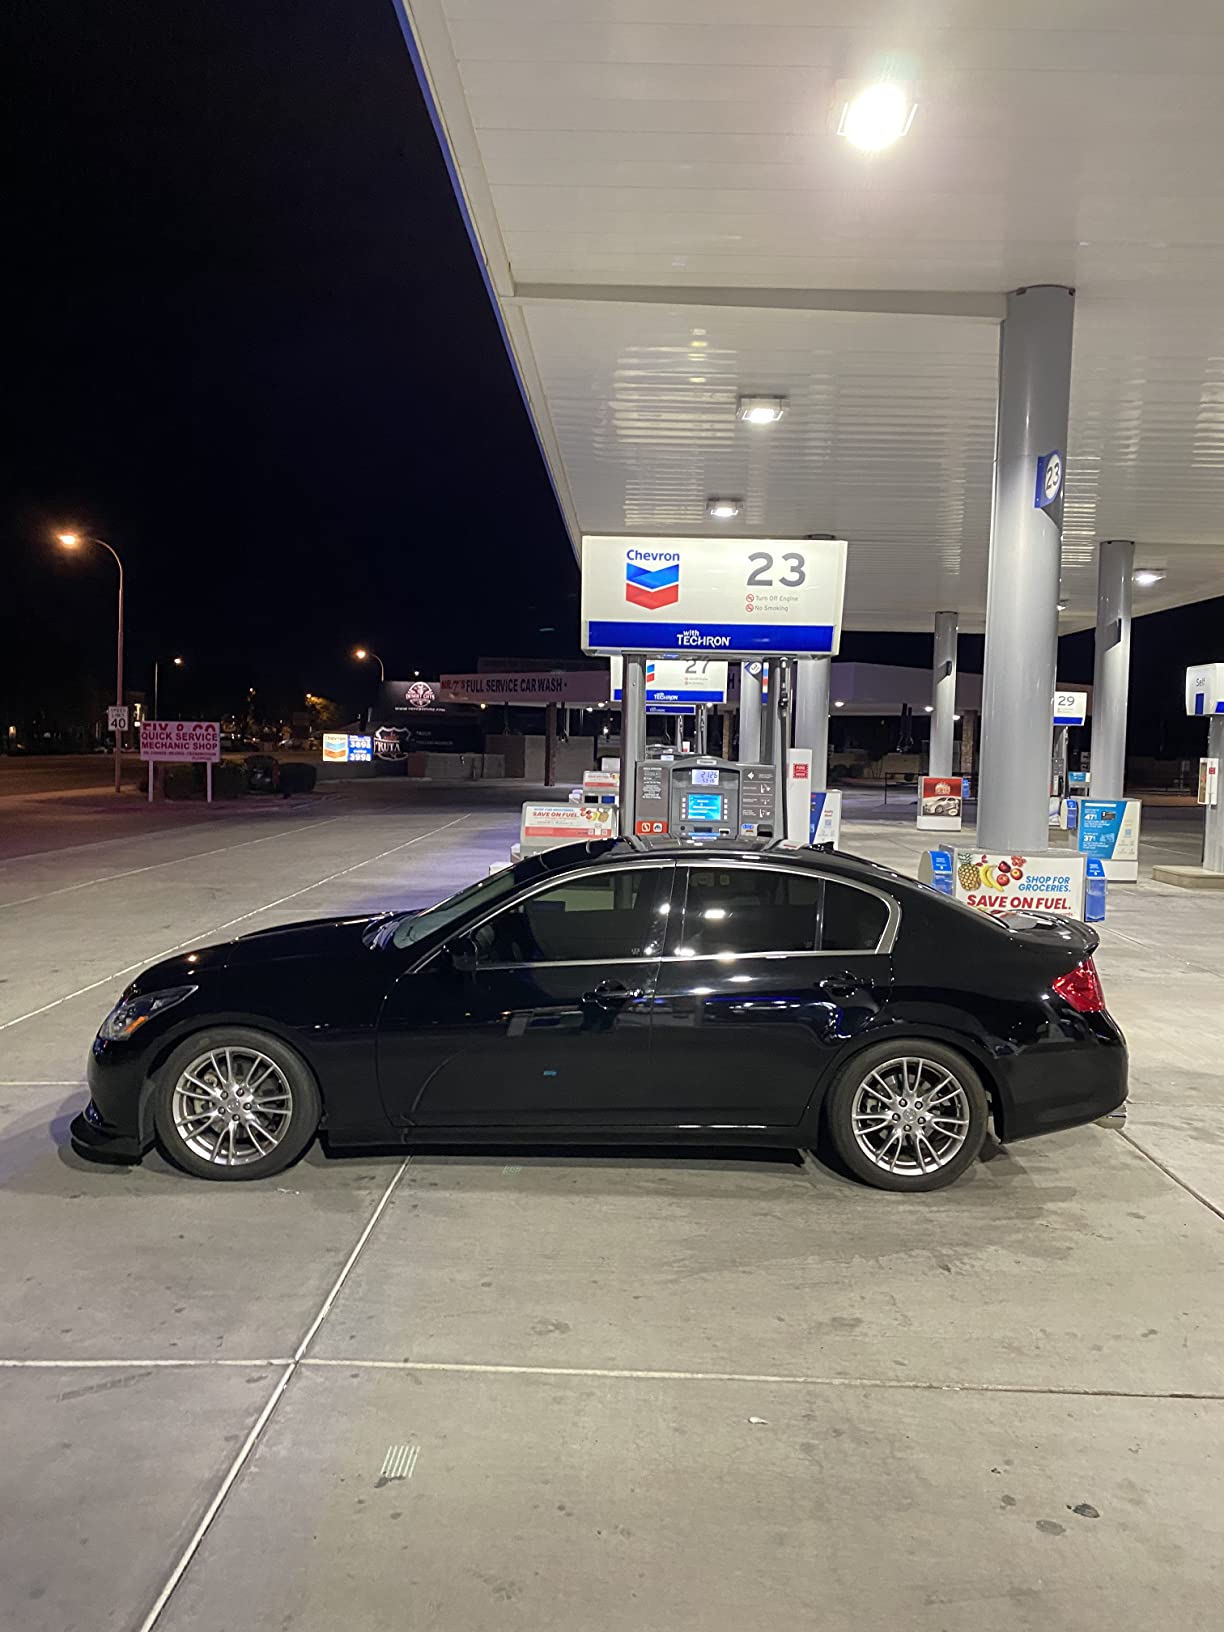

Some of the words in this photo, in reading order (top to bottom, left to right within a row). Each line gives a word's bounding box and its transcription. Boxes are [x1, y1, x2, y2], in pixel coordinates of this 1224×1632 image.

[1046, 462, 1059, 490] 23
[626, 549, 680, 561] Chevron
[747, 552, 806, 587] 23
[779, 595, 799, 603] Engine
[676, 634, 731, 648] TECHRON
[685, 660, 710, 674] 27
[466, 680, 484, 693] FULL
[486, 679, 518, 693] SERVICE
[520, 679, 536, 692] CAR
[536, 678, 562, 692] WASH
[1057, 695, 1075, 706] 29
[110, 718, 126, 729] 40
[141, 731, 172, 741] QUICK
[176, 733, 218, 742] SERVICE
[192, 742, 218, 750] SHOP
[1025, 875, 1051, 884] SHOP
[1052, 876, 1071, 884] FOR
[1018, 883, 1071, 892] GROCERIES.
[967, 894, 1008, 908] SAVE
[1010, 896, 1034, 909] ON
[1035, 897, 1072, 910] FUEL.
